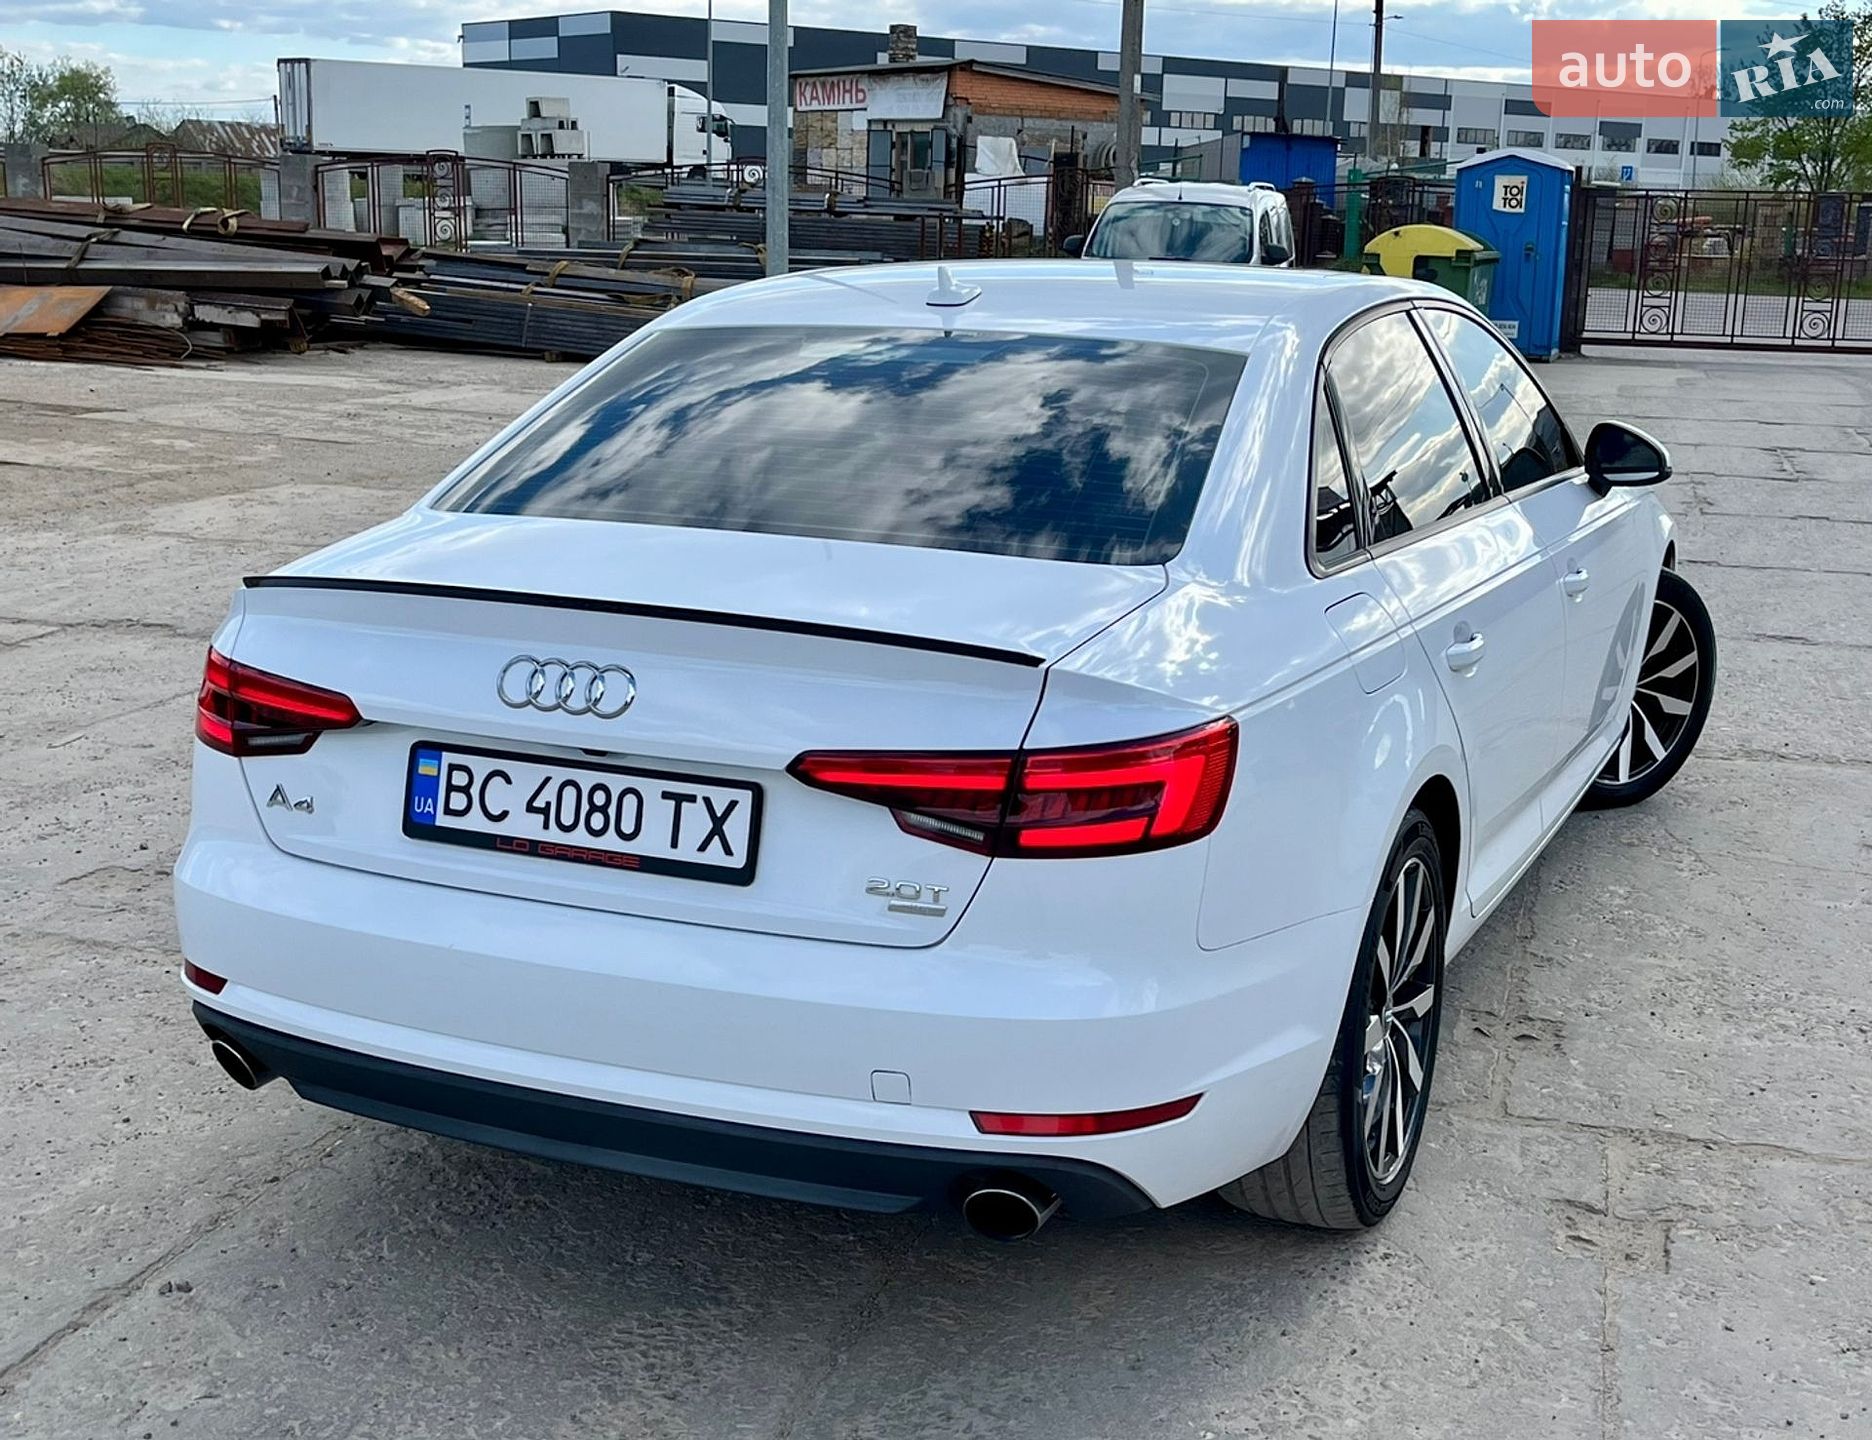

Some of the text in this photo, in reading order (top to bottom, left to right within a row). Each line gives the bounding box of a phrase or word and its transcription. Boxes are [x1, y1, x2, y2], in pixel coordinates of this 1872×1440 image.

[798, 79, 867, 106] КАМІНЬ
[266, 783, 315, 815] A4
[414, 797, 435, 815] UA
[443, 762, 740, 858] BC 4080 TX
[537, 843, 641, 869] GARAGE
[865, 876, 950, 903] 2.0T
